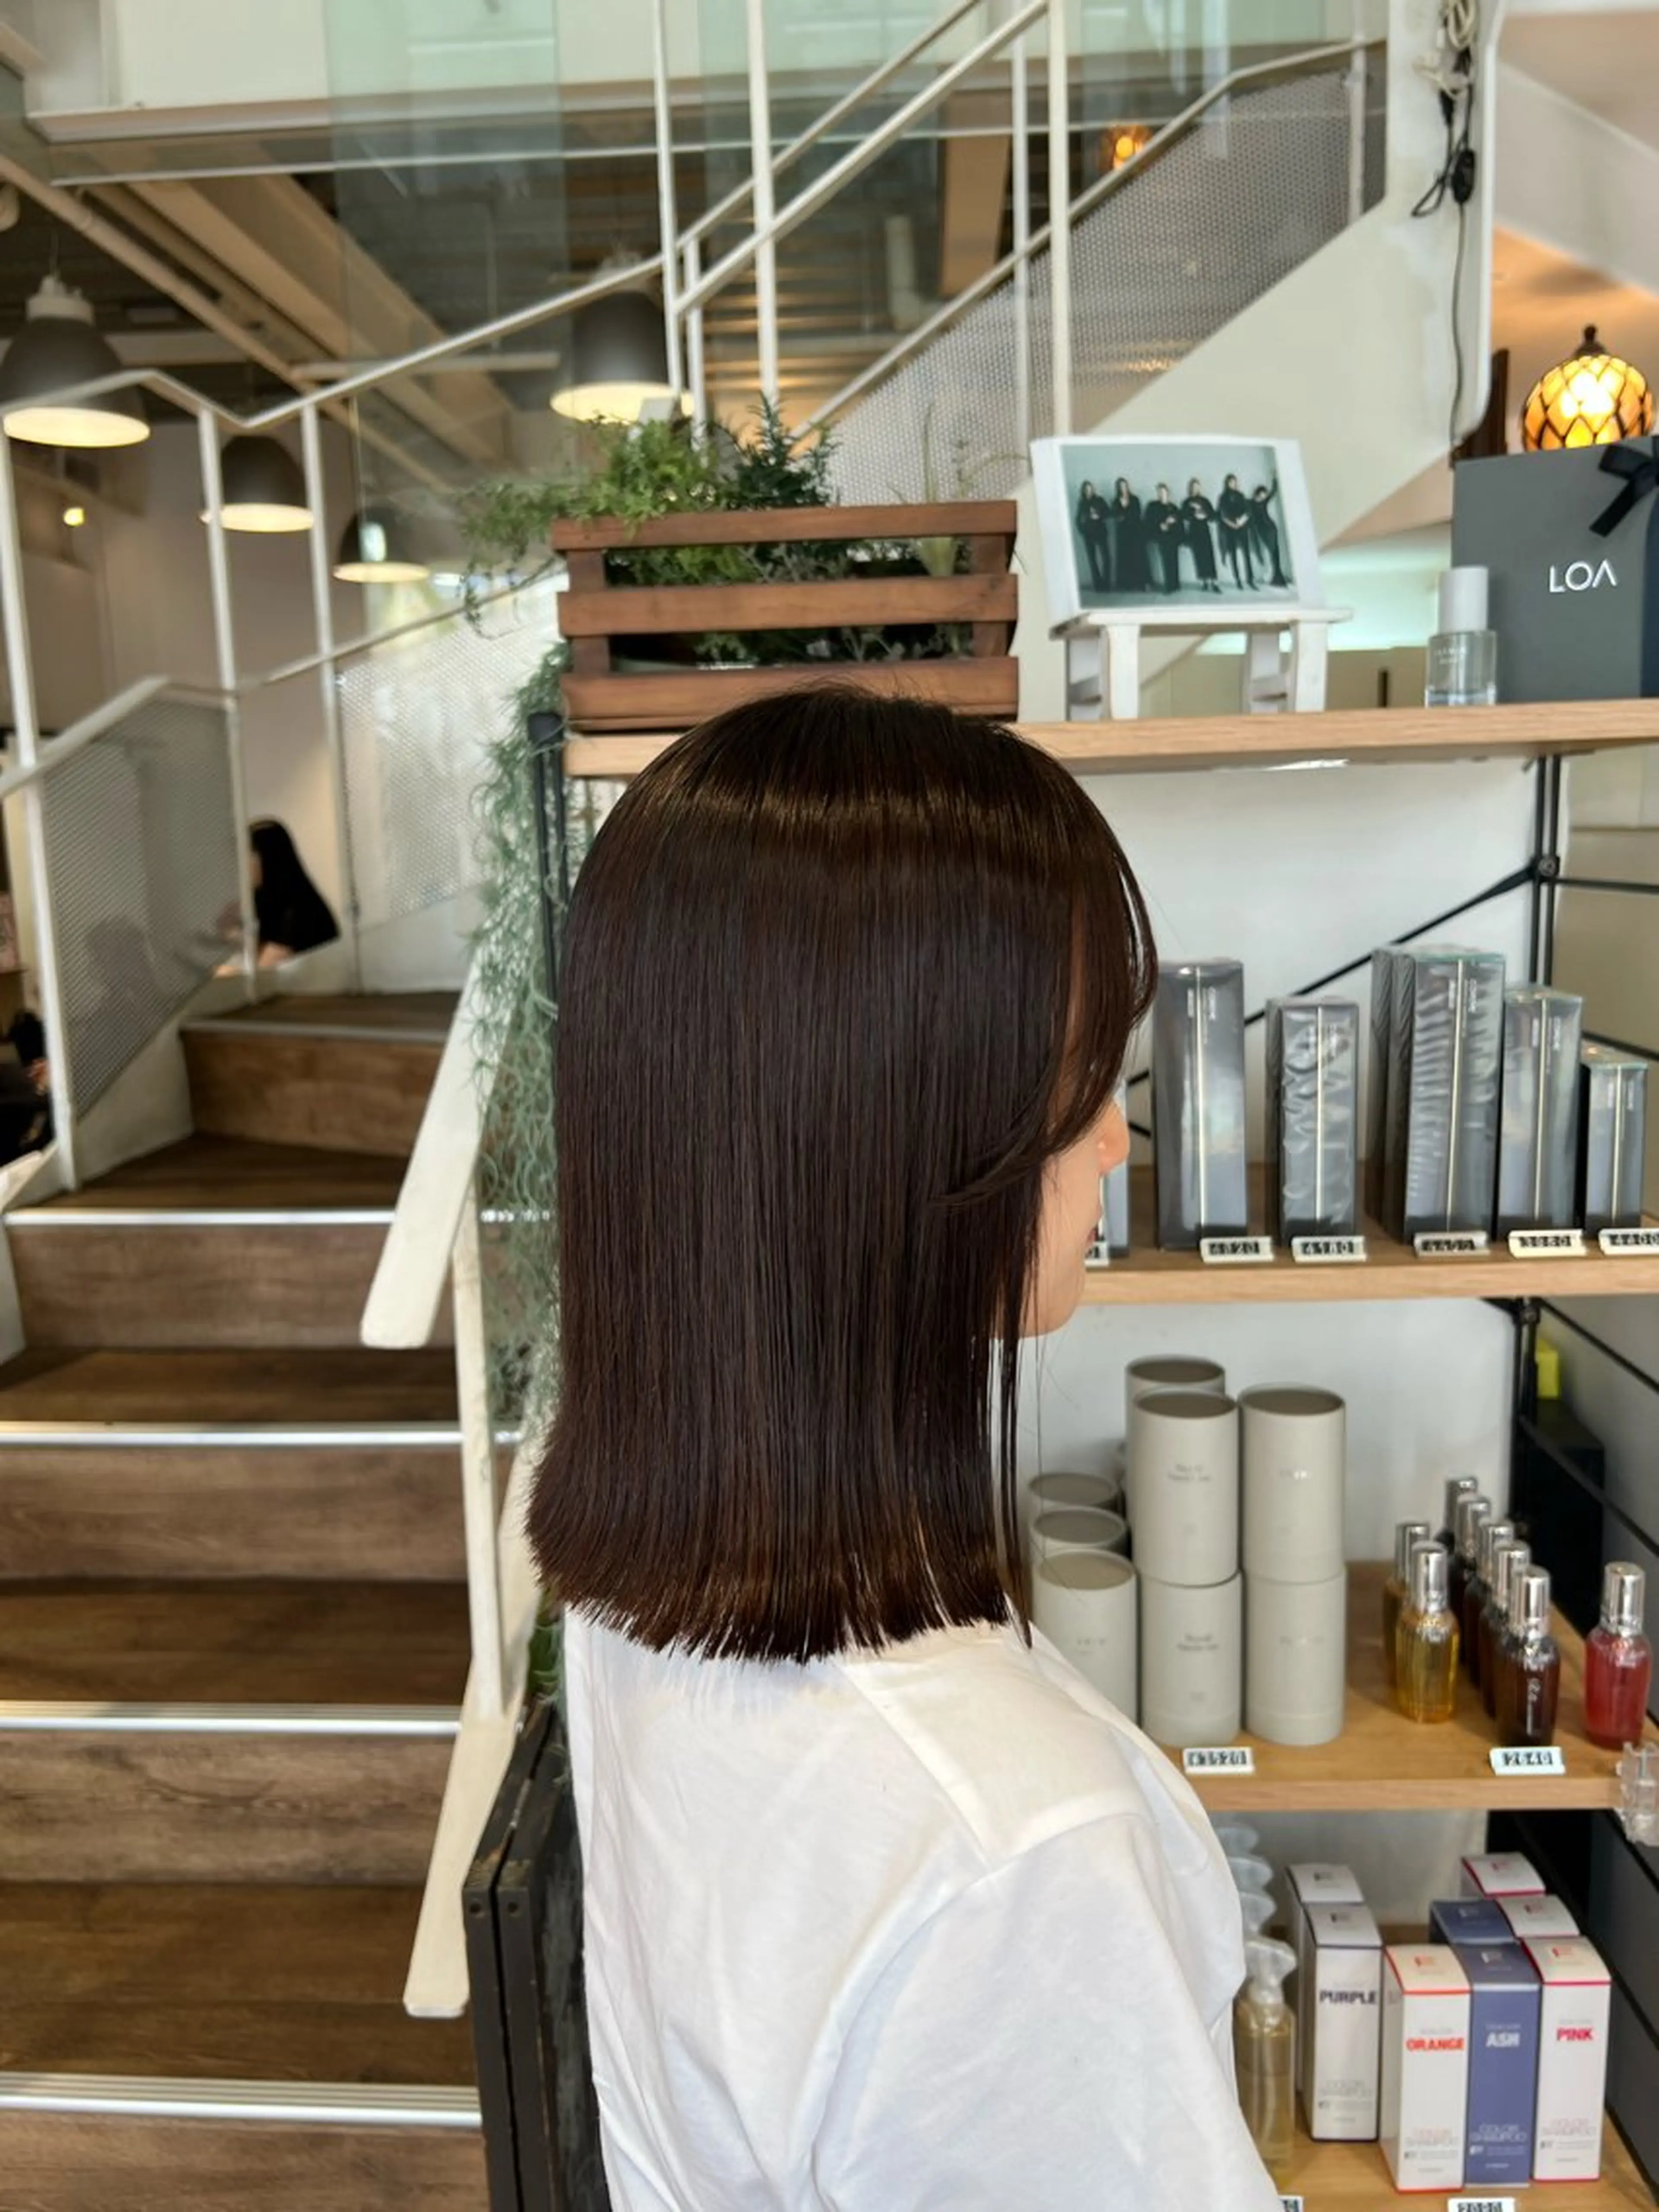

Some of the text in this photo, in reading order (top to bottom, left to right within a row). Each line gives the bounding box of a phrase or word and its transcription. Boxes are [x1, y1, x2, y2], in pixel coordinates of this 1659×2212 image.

[1319, 1990, 1377, 2005] PURPLE
[1485, 2032, 1520, 2047] ASH
[1557, 2027, 1594, 2042] PINK
[1406, 2037, 1465, 2051] ORANGE
